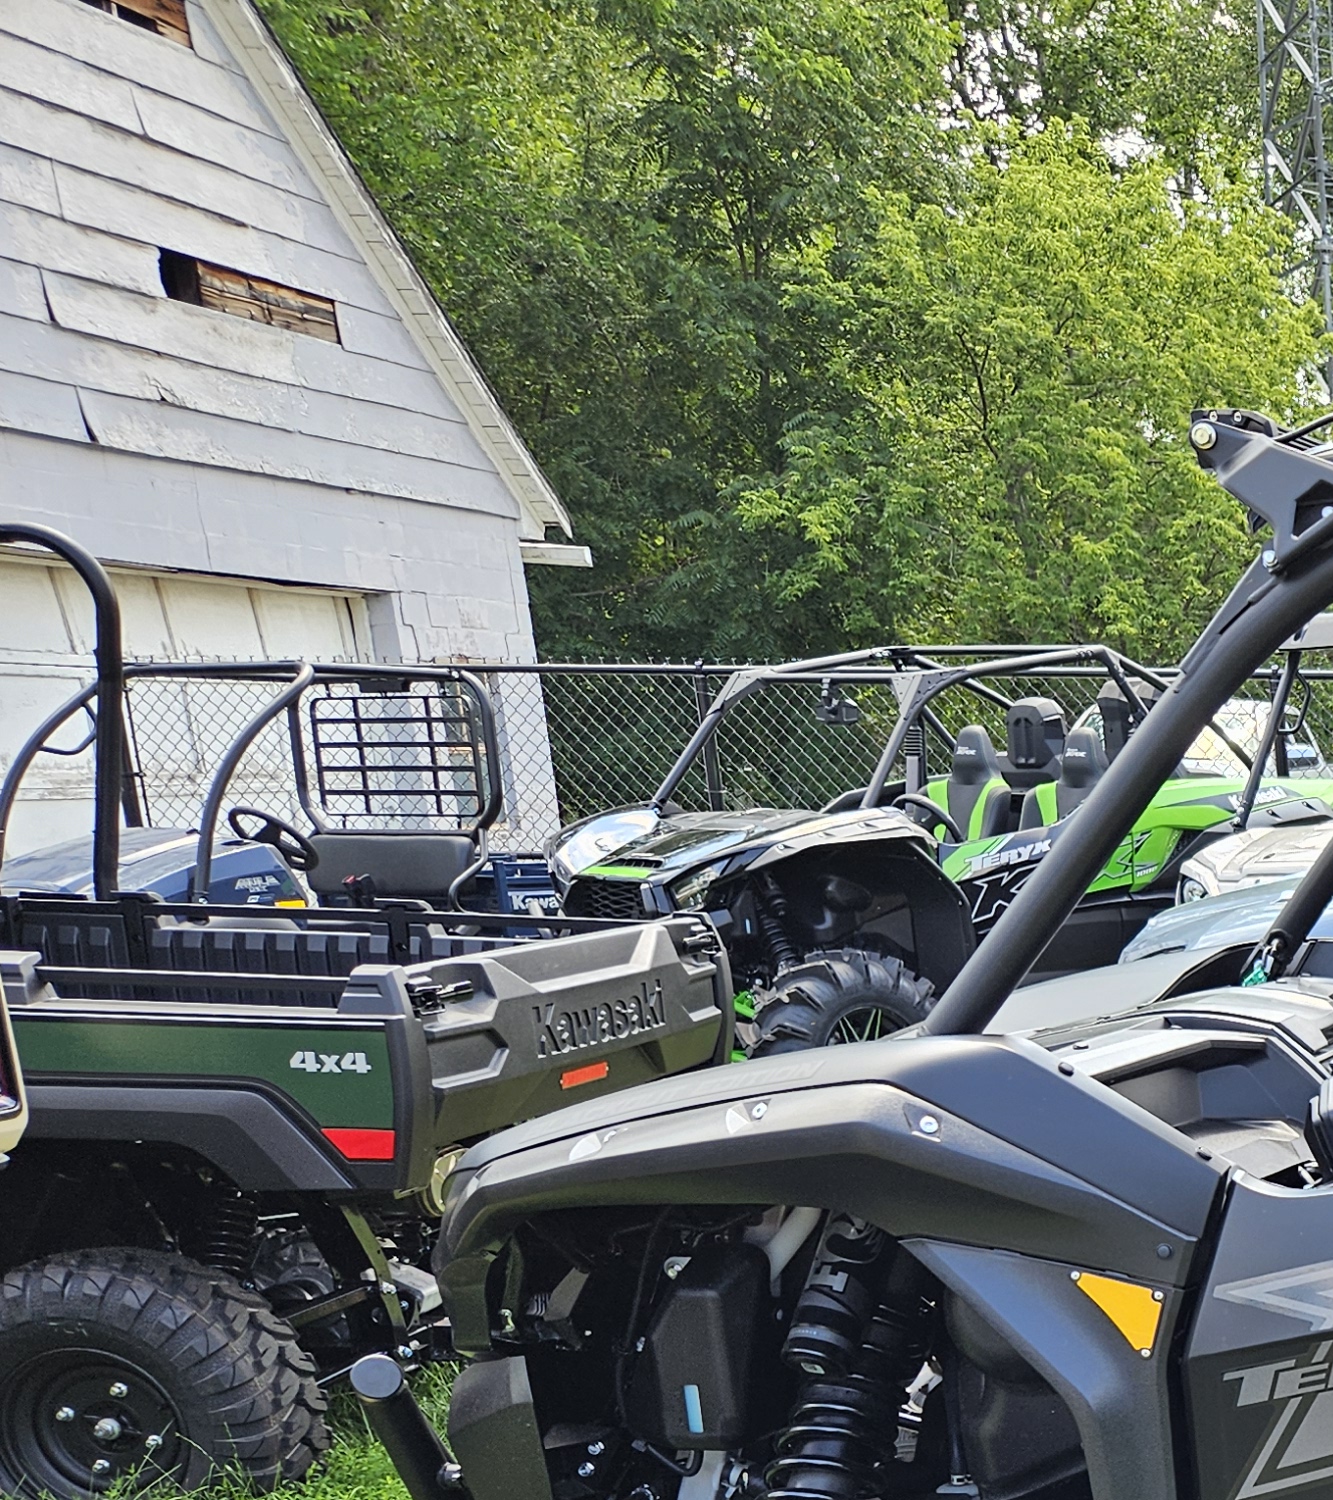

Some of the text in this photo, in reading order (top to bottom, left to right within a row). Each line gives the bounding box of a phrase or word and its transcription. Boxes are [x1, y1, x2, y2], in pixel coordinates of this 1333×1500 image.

[965, 839, 1052, 873] TERYX
[532, 979, 666, 1059] Kawasaki
[289, 1051, 372, 1074] 4x4
